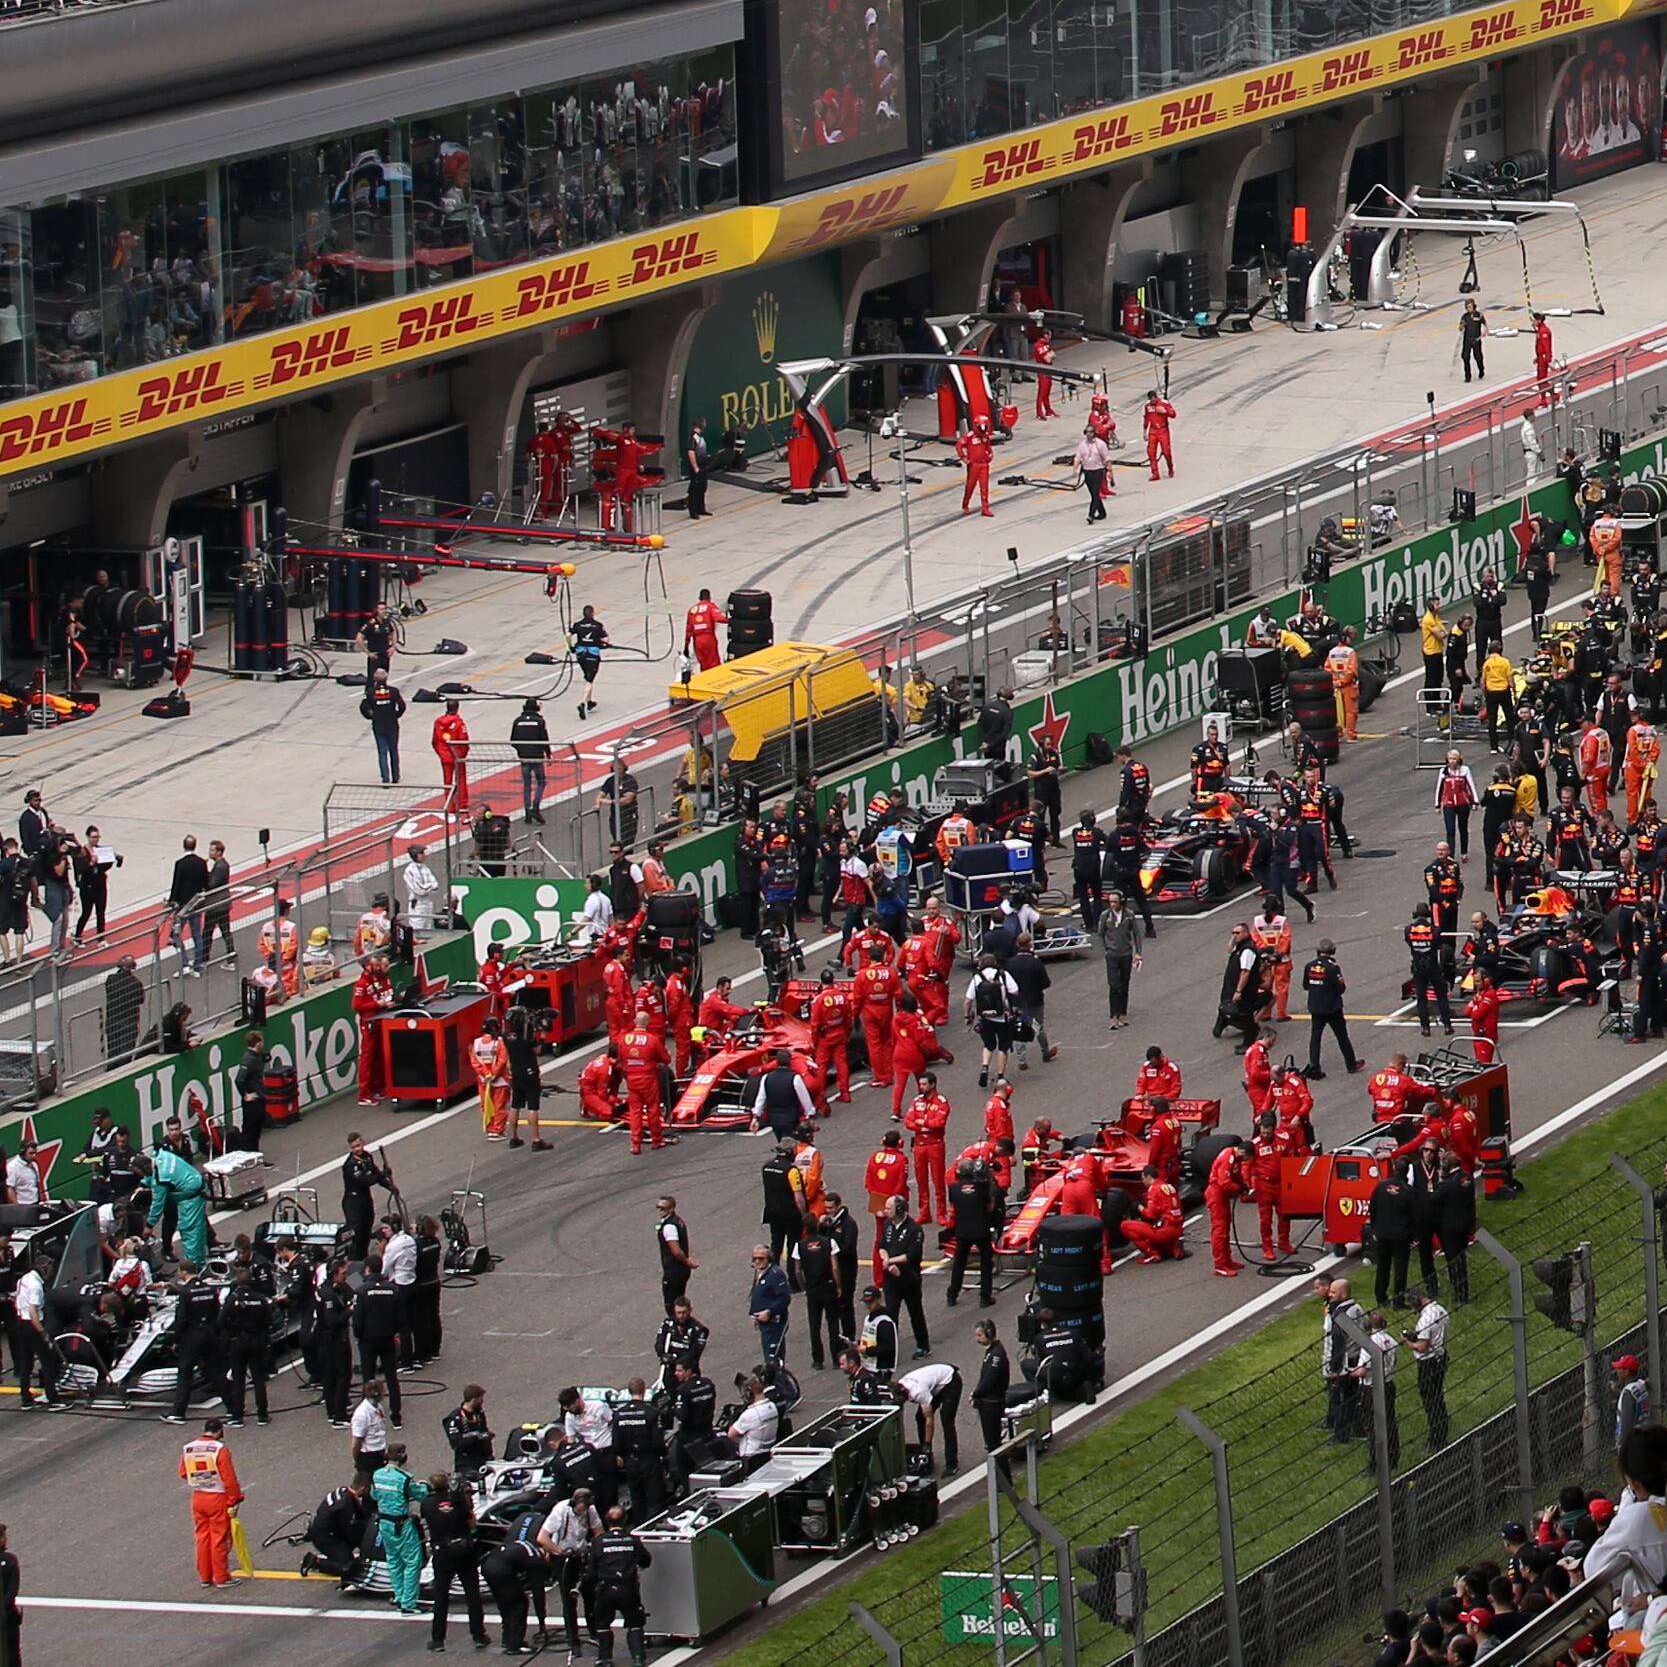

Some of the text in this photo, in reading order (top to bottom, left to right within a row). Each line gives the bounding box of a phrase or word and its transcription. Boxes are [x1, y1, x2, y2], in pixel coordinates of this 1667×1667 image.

[982, 139, 1045, 187] DHL
[1073, 115, 1132, 162] DHL
[1160, 92, 1217, 137] DHL
[1244, 70, 1297, 114] DHL
[1322, 49, 1374, 93] DHL
[1398, 30, 1447, 71] DHL
[1470, 11, 1517, 50] DHL
[814, 184, 912, 237] DHL
[0, 232, 703, 462] DHL DHL DHL DHL DHL DHL
[1362, 528, 1507, 622] Heineken
